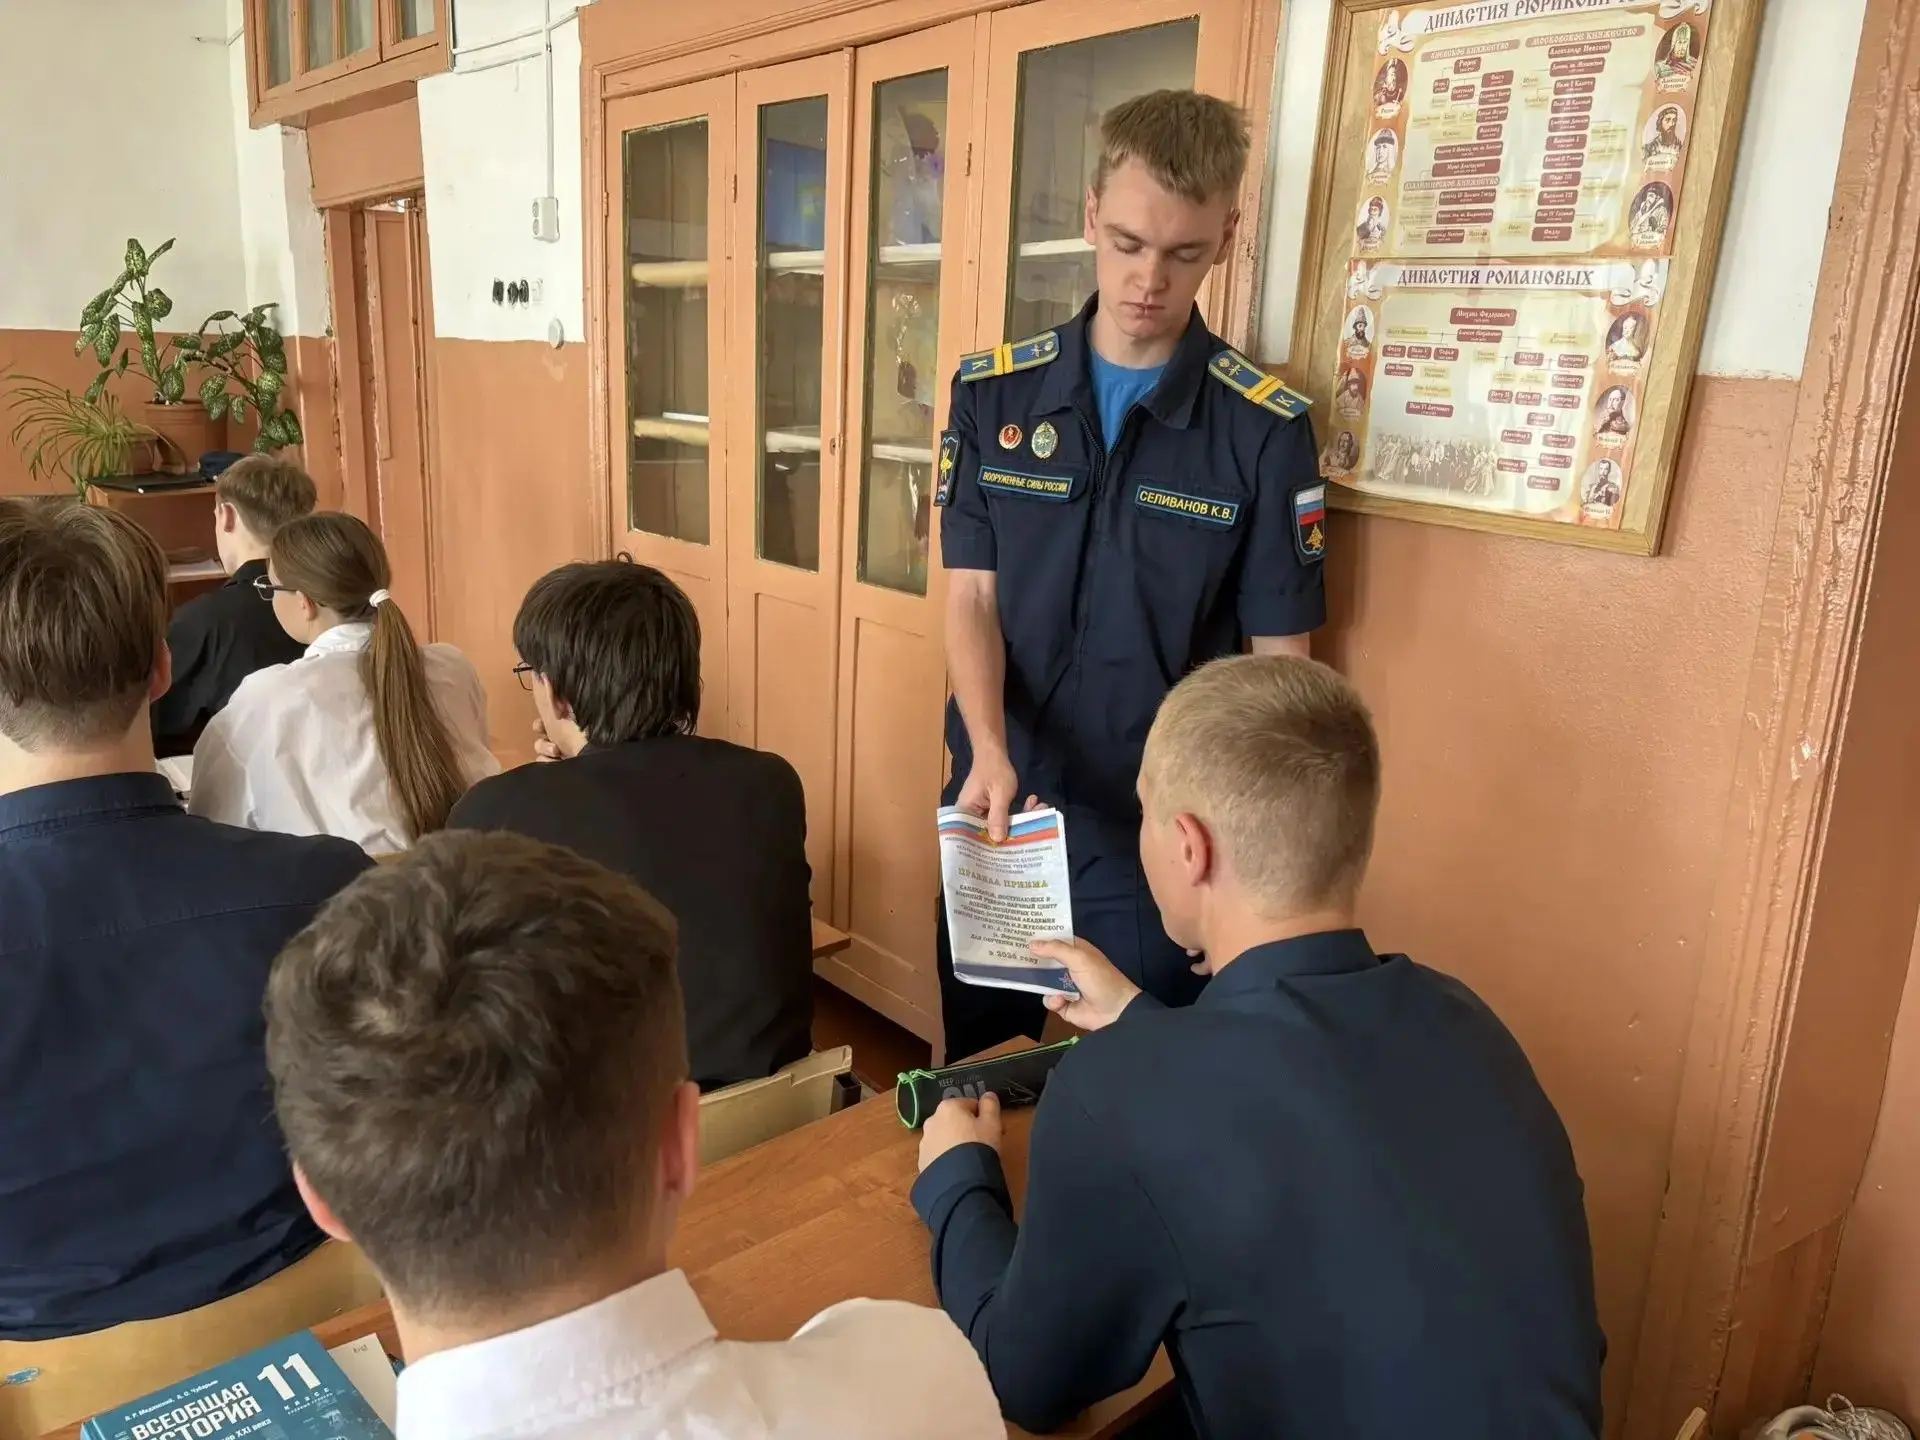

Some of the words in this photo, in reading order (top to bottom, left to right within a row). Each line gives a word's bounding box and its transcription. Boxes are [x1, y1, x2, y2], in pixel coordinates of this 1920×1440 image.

[1424, 4, 1510, 32] ДИНАСТИЯ
[1397, 269, 1481, 286] ДИНАСТИЯ
[1485, 270, 1594, 286] РОМАНОВЫХ
[982, 471, 1026, 487] ВООРУЖЕННЫЕ
[1026, 479, 1044, 489] СИЛЫ
[1044, 480, 1069, 493] РОССИИ
[1139, 490, 1209, 515] СЕЛИВАНОВ
[1210, 505, 1233, 520] К.В.
[958, 867, 1001, 886] ПРАВИЛА
[998, 895, 1044, 903] ПОСТУПАЮЩИХ
[256, 1352, 322, 1401] 11
[131, 1381, 250, 1440] ВСЕОБЩАЯ
[236, 1426, 252, 1438] XXI
[252, 1418, 272, 1431] века
